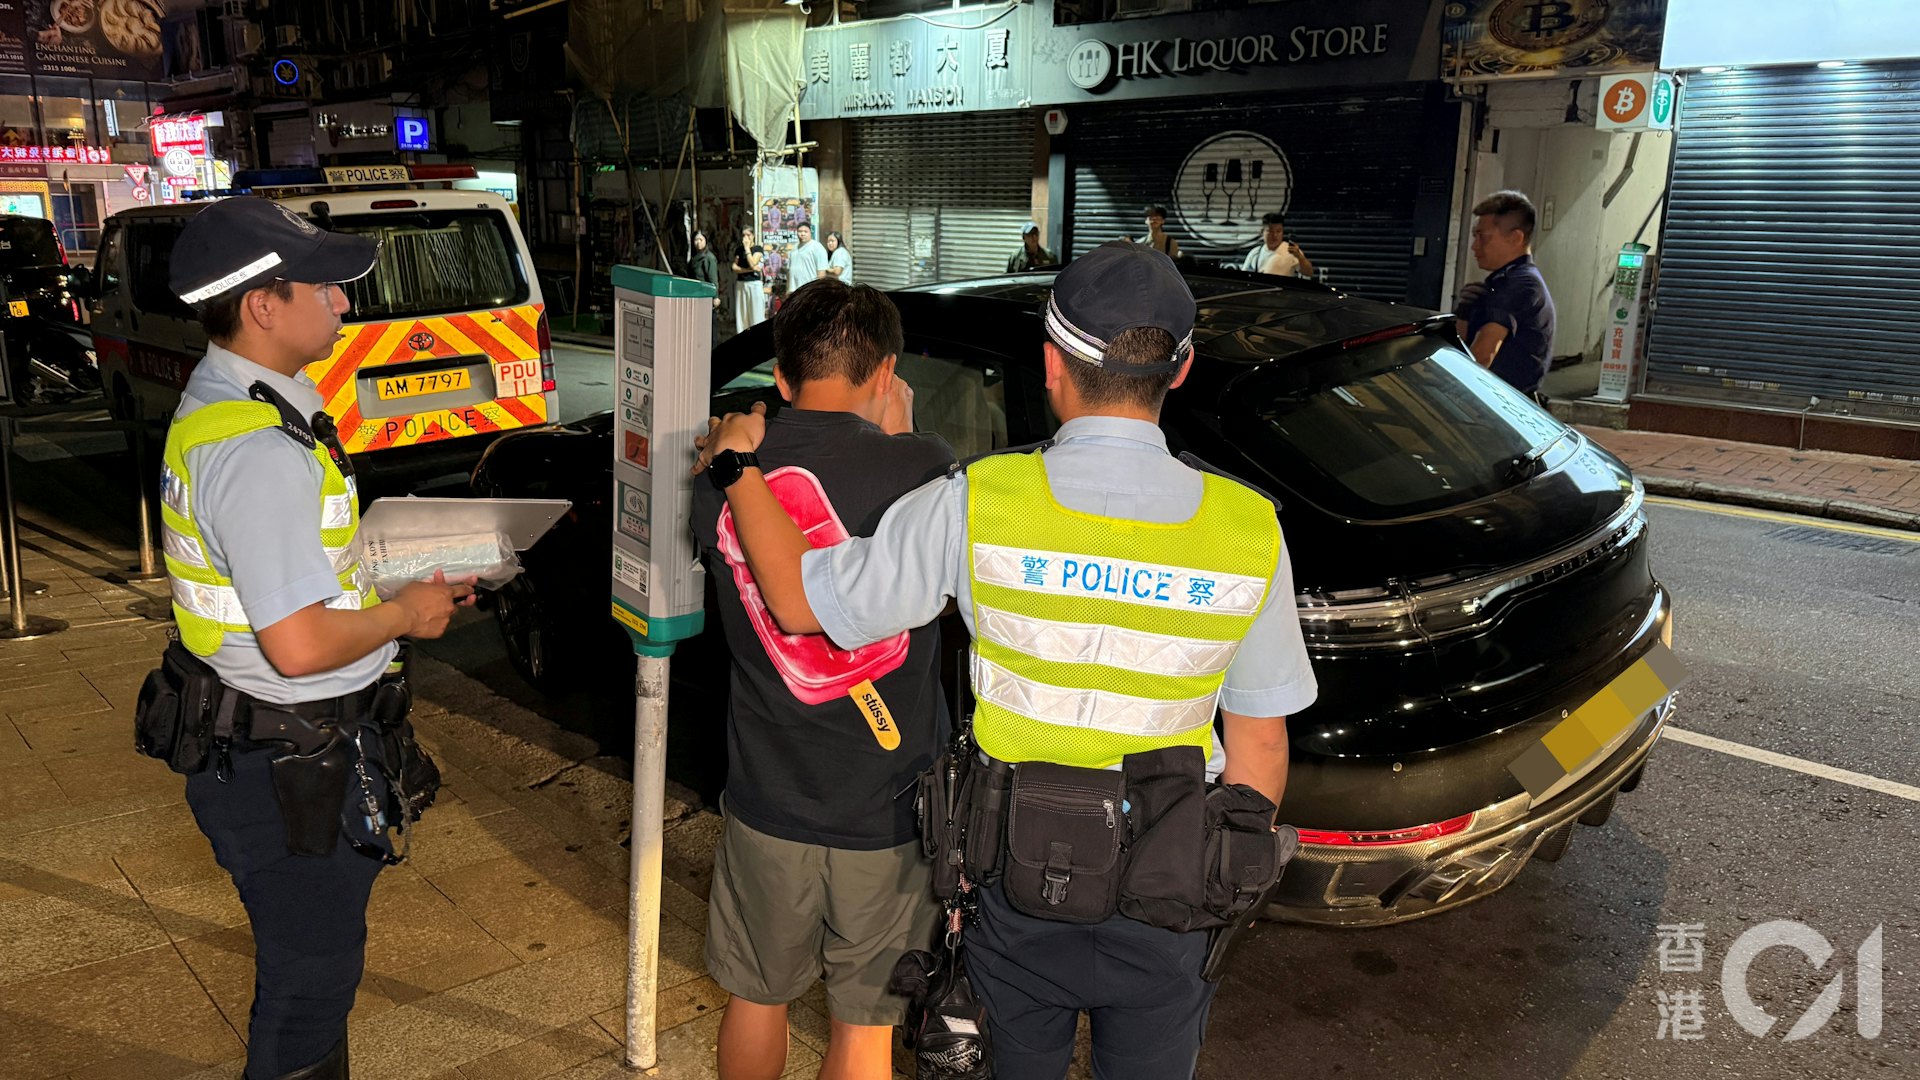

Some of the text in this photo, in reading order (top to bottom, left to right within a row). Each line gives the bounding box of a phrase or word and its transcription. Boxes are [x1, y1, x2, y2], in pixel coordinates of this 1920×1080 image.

[35, 43, 96, 55] ENCHANTING
[36, 52, 127, 67] CANTONESE CUISINE
[1116, 23, 1388, 77] HK LIQUOR STORE
[403, 120, 423, 143] P
[328, 167, 405, 182] 警 POLICE 察
[212, 274, 241, 294] POLICE
[501, 361, 537, 382] PDU
[385, 372, 463, 397] AM 7797
[513, 379, 528, 397] 11
[357, 423, 379, 445] 警
[385, 409, 477, 442] POLICE
[1020, 555, 1216, 606] 警 POLICE 察
[862, 693, 891, 732] stüssy
